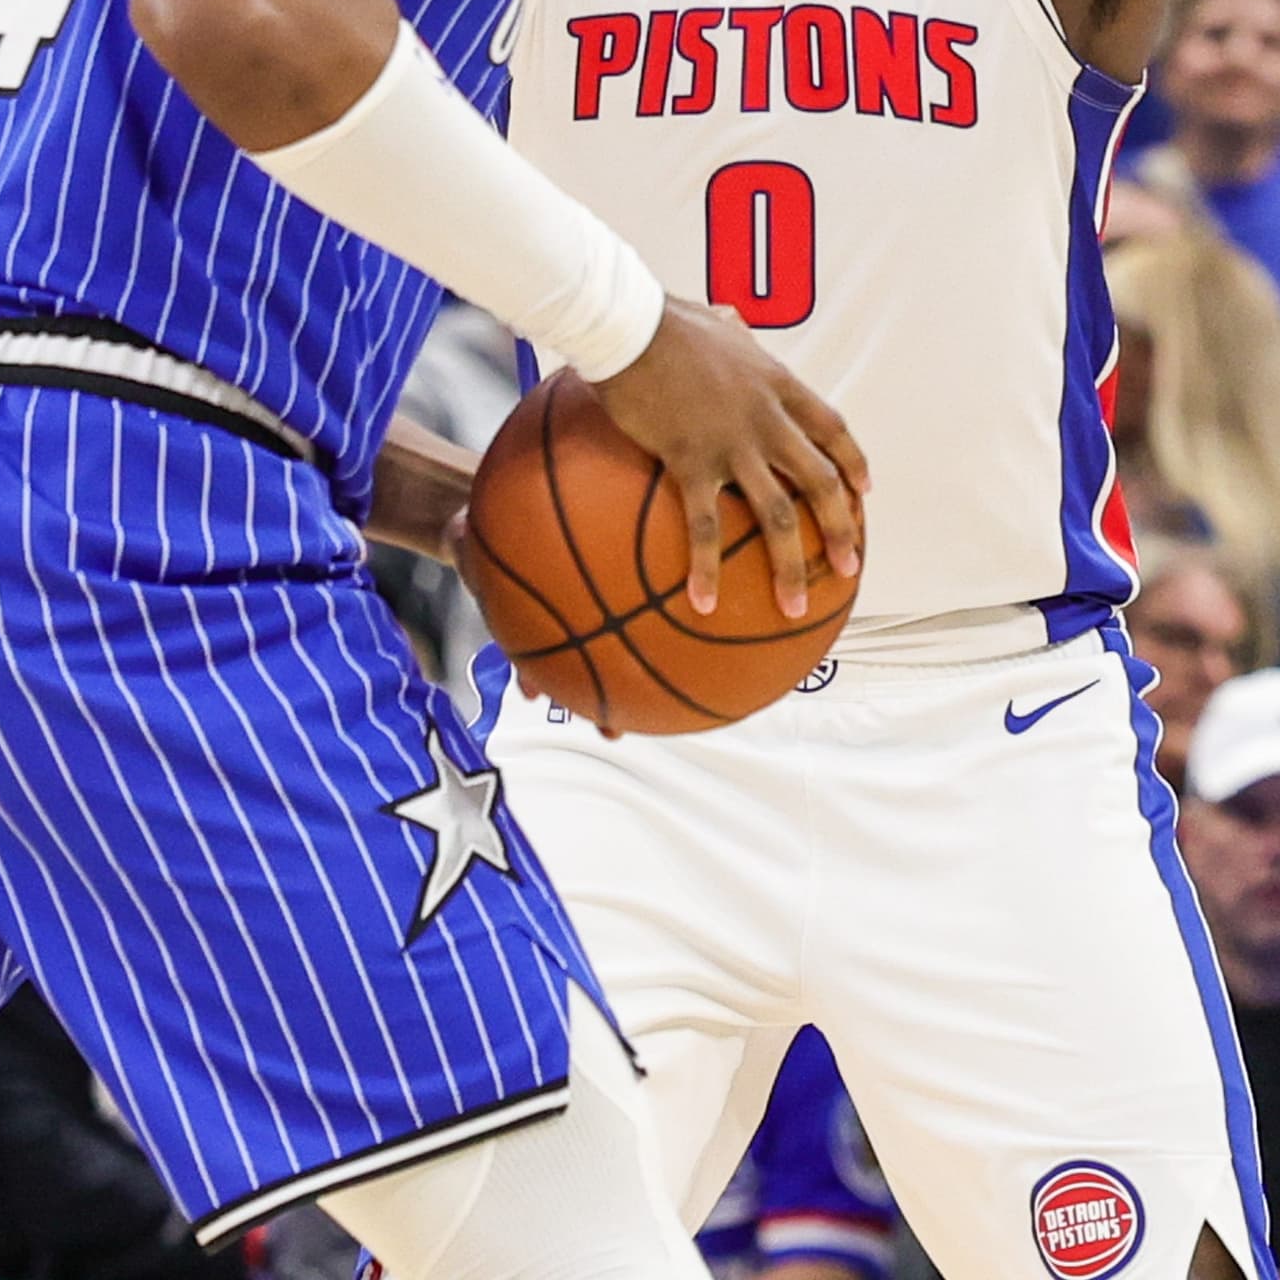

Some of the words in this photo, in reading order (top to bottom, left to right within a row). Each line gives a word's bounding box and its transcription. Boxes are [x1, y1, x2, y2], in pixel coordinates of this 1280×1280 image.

[567, 4, 978, 129] PISTONS
[705, 160, 816, 328] 0
[1043, 1198, 1118, 1231] DETROIT
[1046, 1219, 1121, 1252] PISTONS
